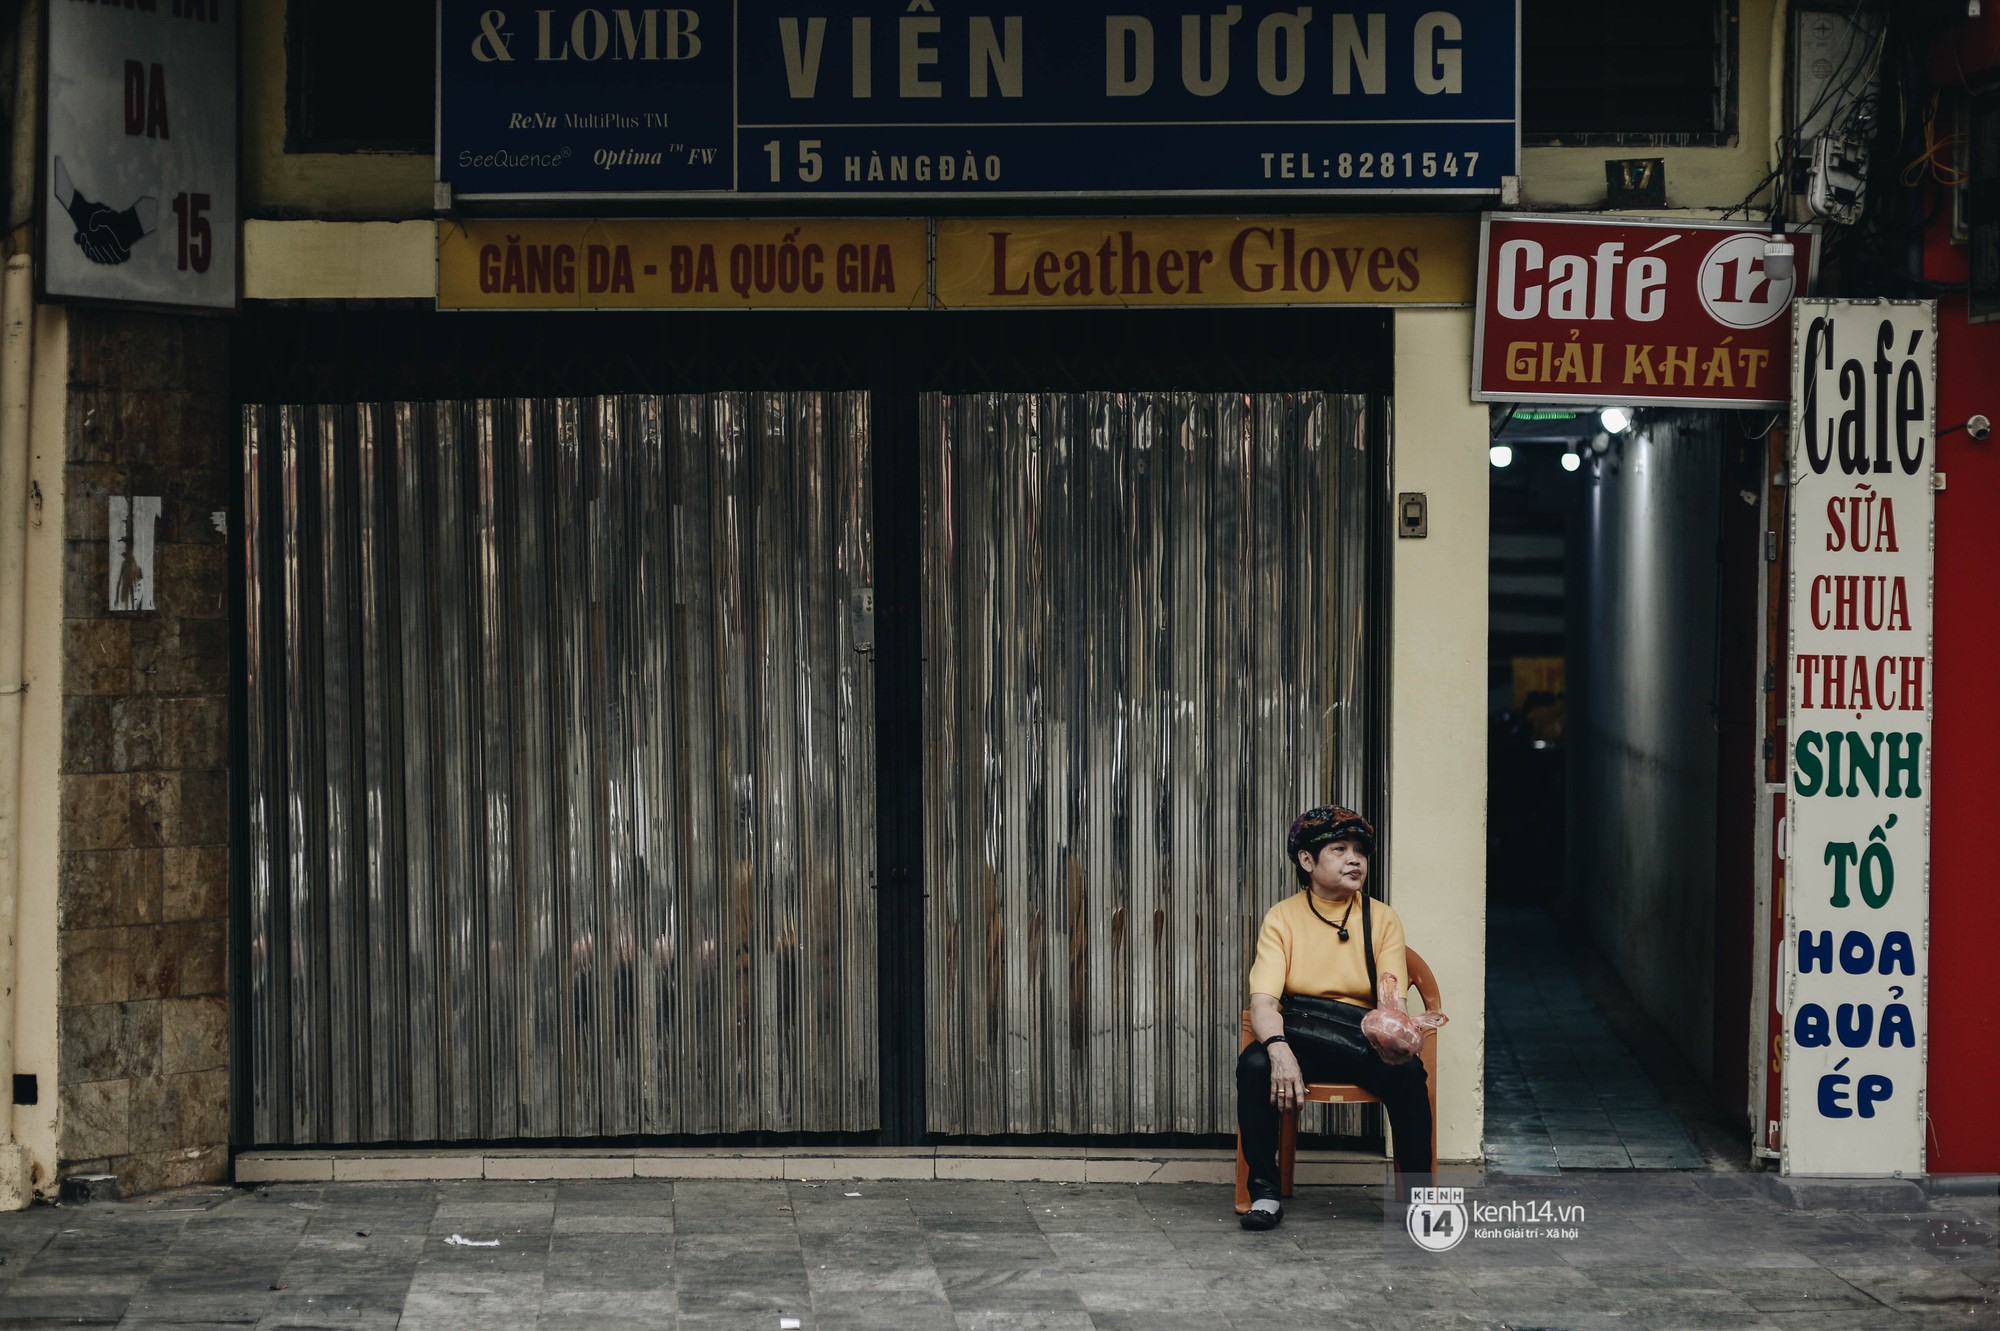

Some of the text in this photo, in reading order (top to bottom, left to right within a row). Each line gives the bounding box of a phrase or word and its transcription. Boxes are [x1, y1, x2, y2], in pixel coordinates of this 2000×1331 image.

[471, 8, 702, 62] & LOMB
[778, 0, 1464, 98] VIÊN DƯƠNG
[124, 59, 170, 140] DA
[508, 111, 670, 130] ReNu MultiPlus TM
[593, 146, 663, 171] Optima
[687, 147, 719, 166] FW
[763, 140, 824, 184] 15
[1261, 151, 1480, 179] TEL:8281547
[1621, 160, 1655, 190] 17
[172, 192, 212, 274] 15
[479, 234, 576, 294] GĂNG
[588, 245, 635, 293] DA
[670, 244, 719, 293] ĐA
[730, 227, 825, 299] QUỐC
[836, 243, 896, 293] GIA
[988, 226, 1420, 297] Leather Gloves
[1496, 234, 1771, 322] Café 17
[1505, 328, 1769, 389] GIẢI KHÁT
[1804, 316, 1925, 475] Café
[1826, 483, 1900, 553] SỮA
[1810, 574, 1912, 632] CHUA
[1796, 654, 1925, 720] THẠCH
[1794, 730, 1923, 798] SINH
[1824, 813, 1898, 909] TỐ
[1798, 929, 1915, 976] HOA
[1794, 985, 1916, 1048] QUẢ
[1817, 1057, 1893, 1119] ÉP
